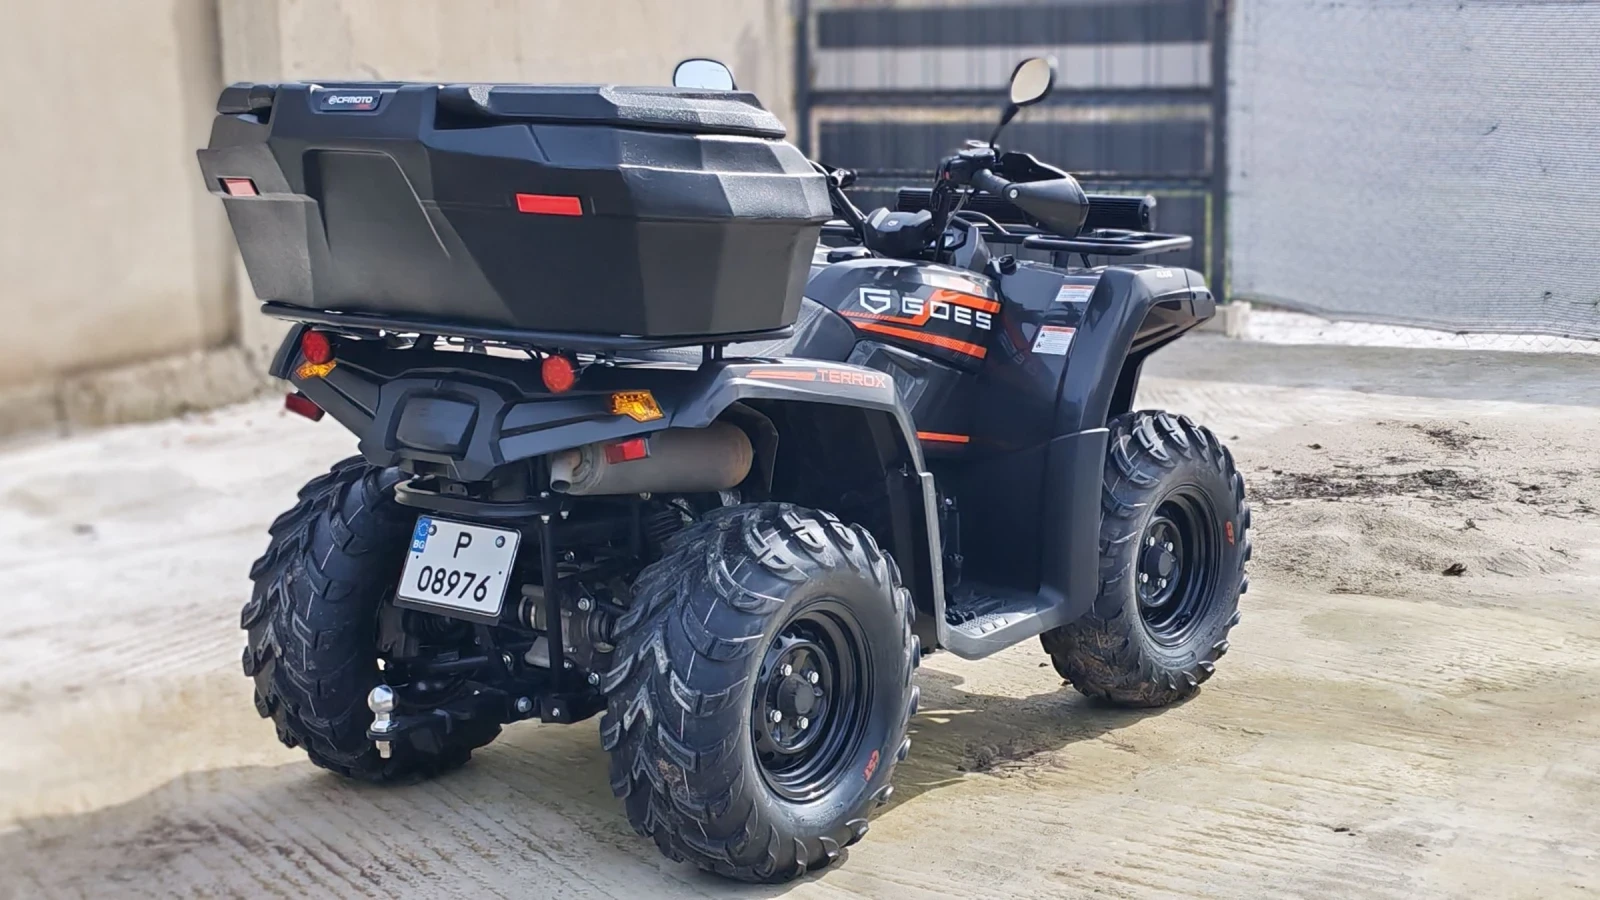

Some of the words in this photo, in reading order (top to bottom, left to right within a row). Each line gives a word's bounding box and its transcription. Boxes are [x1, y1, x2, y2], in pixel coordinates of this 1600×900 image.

[902, 296, 992, 330] GOES
[816, 367, 886, 389] TERROX
[413, 539, 425, 549] BG
[453, 532, 472, 558] P
[417, 565, 491, 602] 08976
